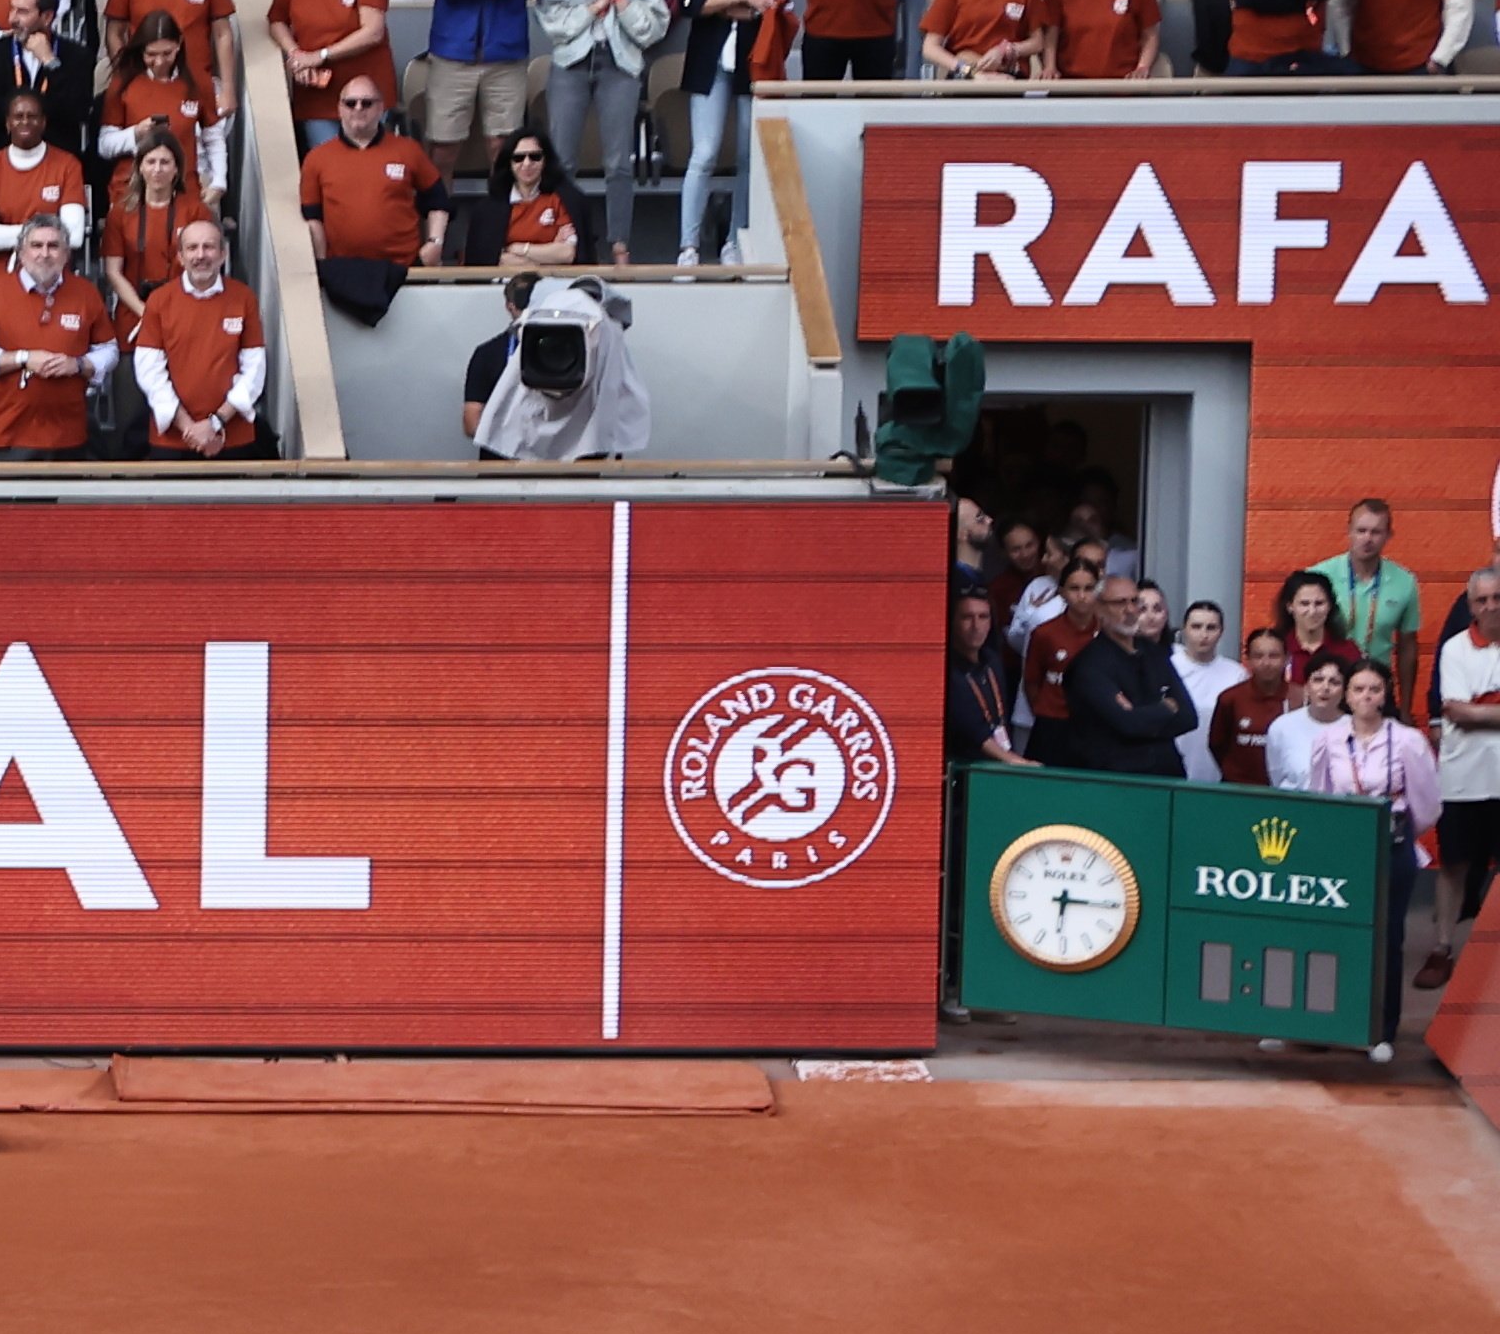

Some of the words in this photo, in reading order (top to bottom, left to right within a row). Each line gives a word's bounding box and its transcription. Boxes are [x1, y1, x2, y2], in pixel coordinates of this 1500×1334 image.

[937, 160, 1488, 307] RAFA
[680, 683, 775, 802] ROLAND
[788, 683, 879, 801] GARROS
[710, 830, 847, 869] PARIS
[1195, 865, 1350, 909] ROLEX
